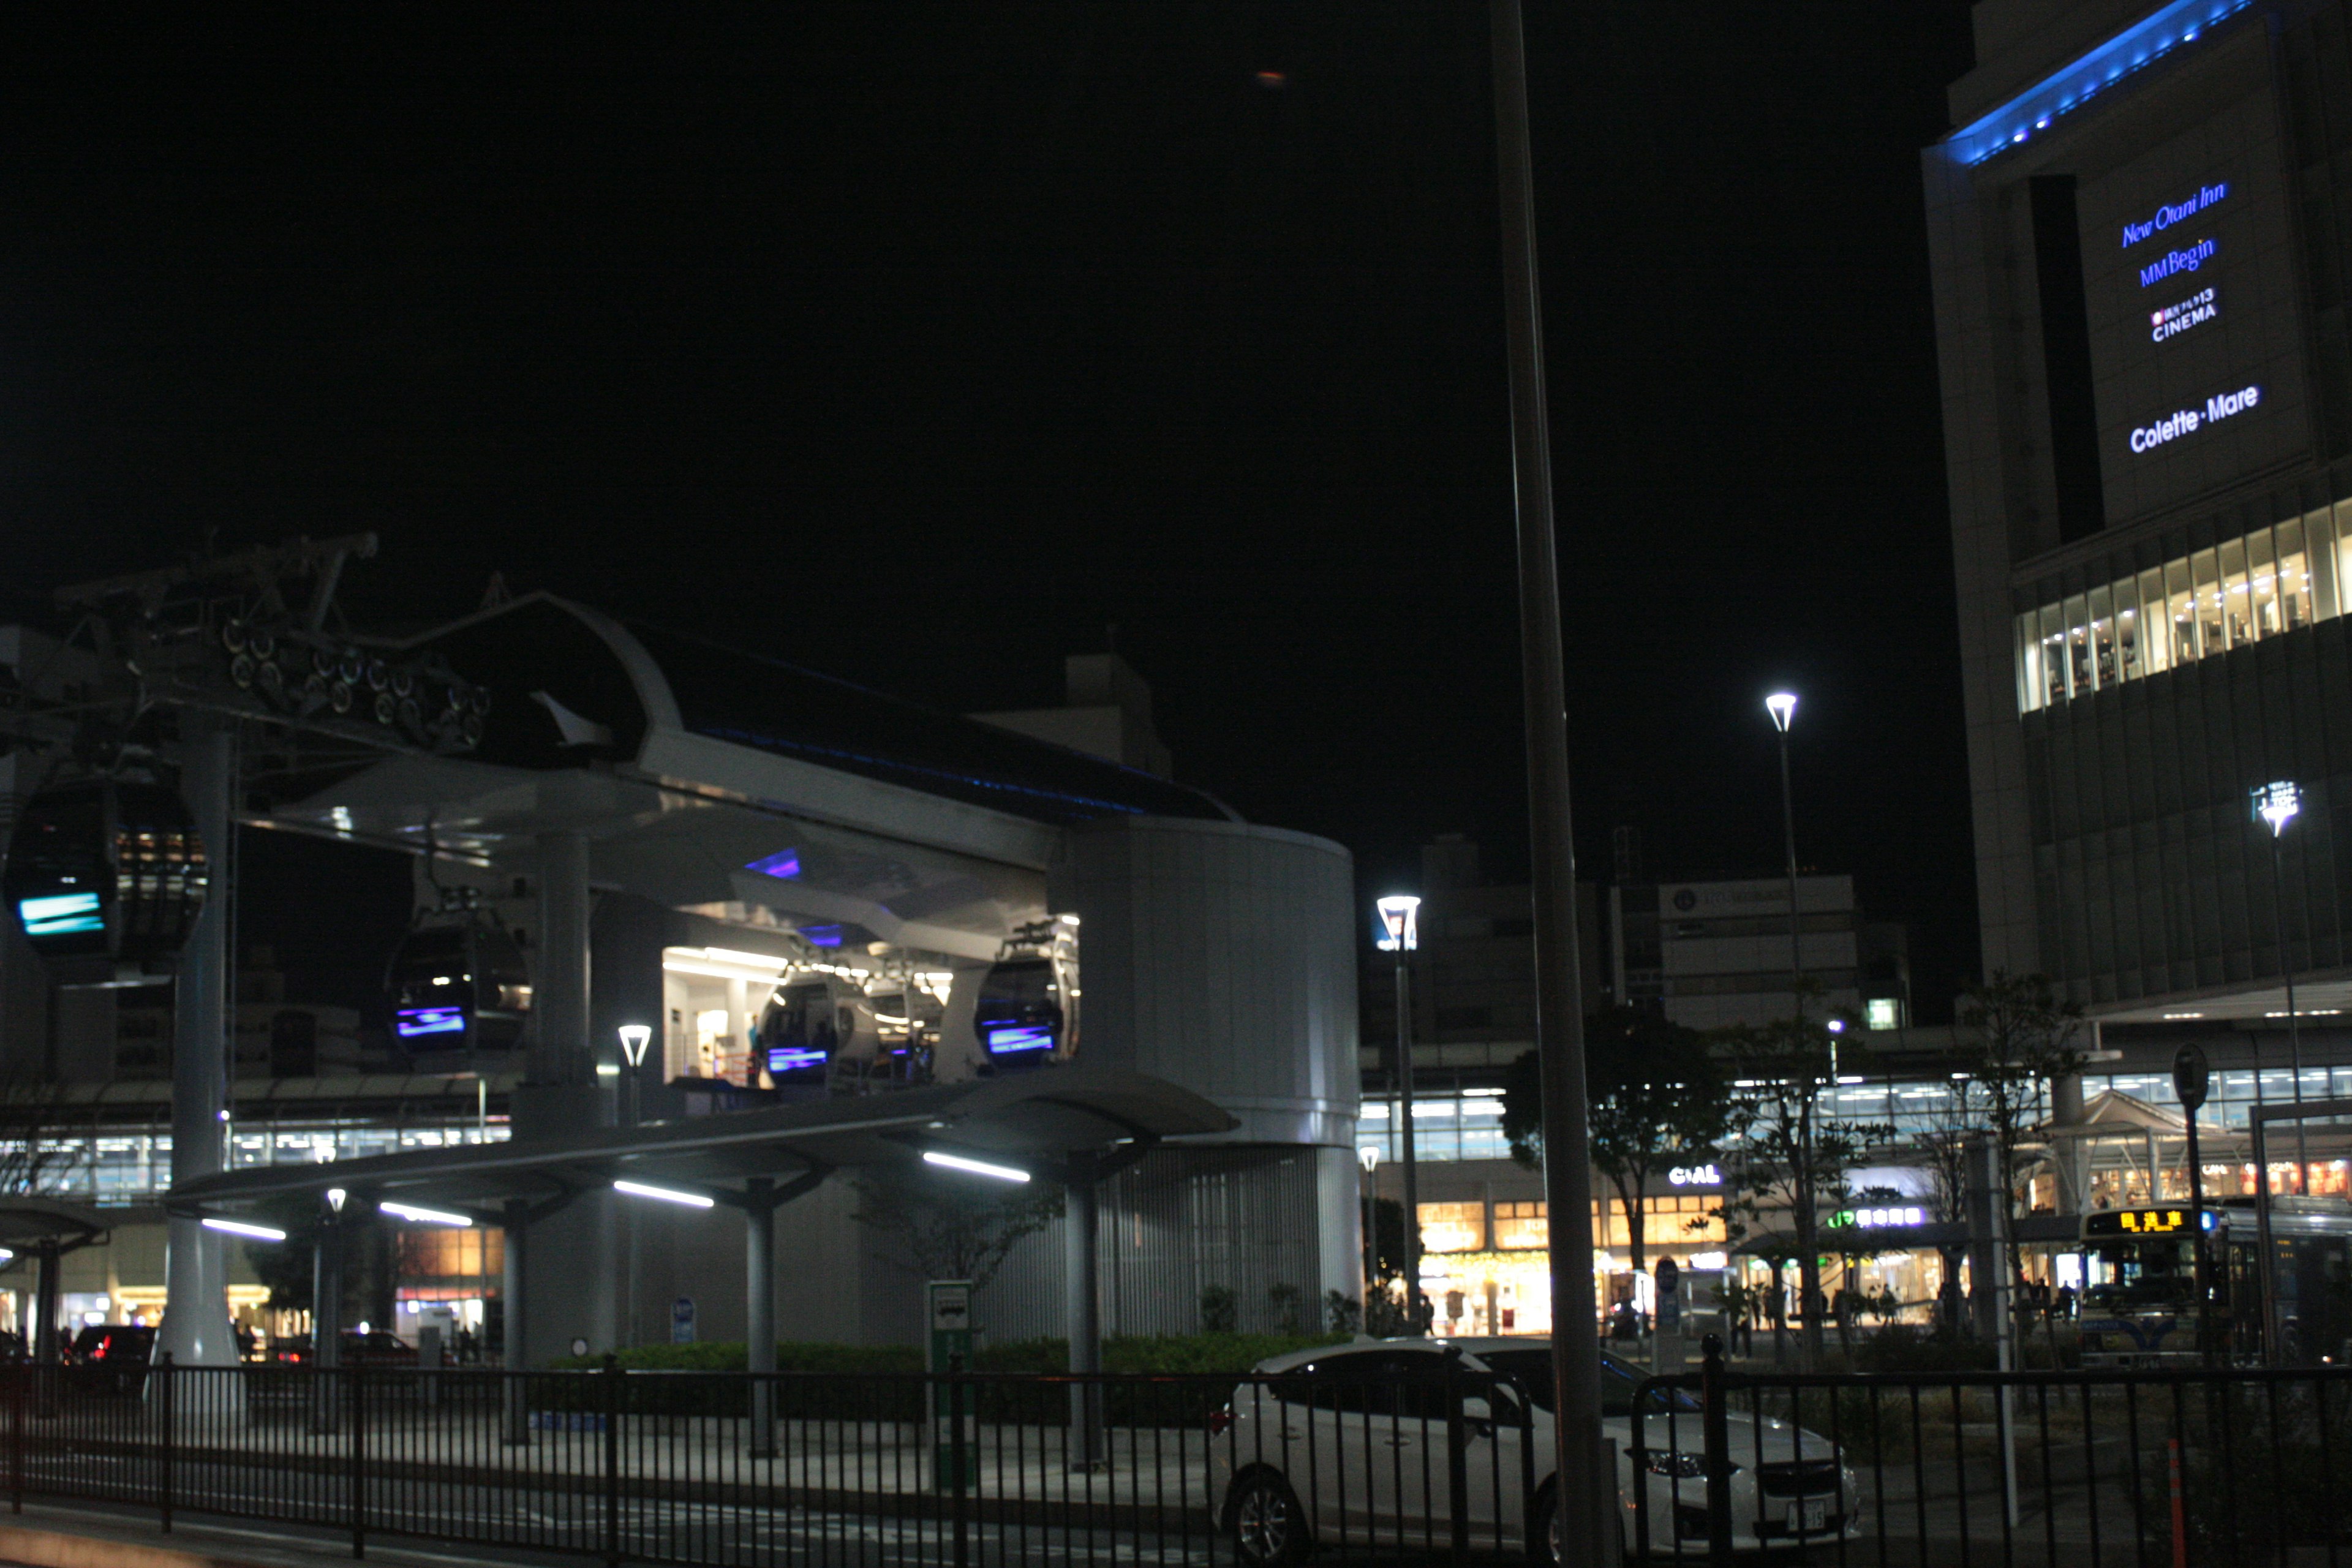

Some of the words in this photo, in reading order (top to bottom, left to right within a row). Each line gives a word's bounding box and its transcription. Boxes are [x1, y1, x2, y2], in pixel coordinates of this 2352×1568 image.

[2122, 221, 2154, 248] New
[2155, 194, 2197, 230] Otani
[2200, 184, 2225, 209] Inn
[2152, 304, 2216, 342] CINEMA
